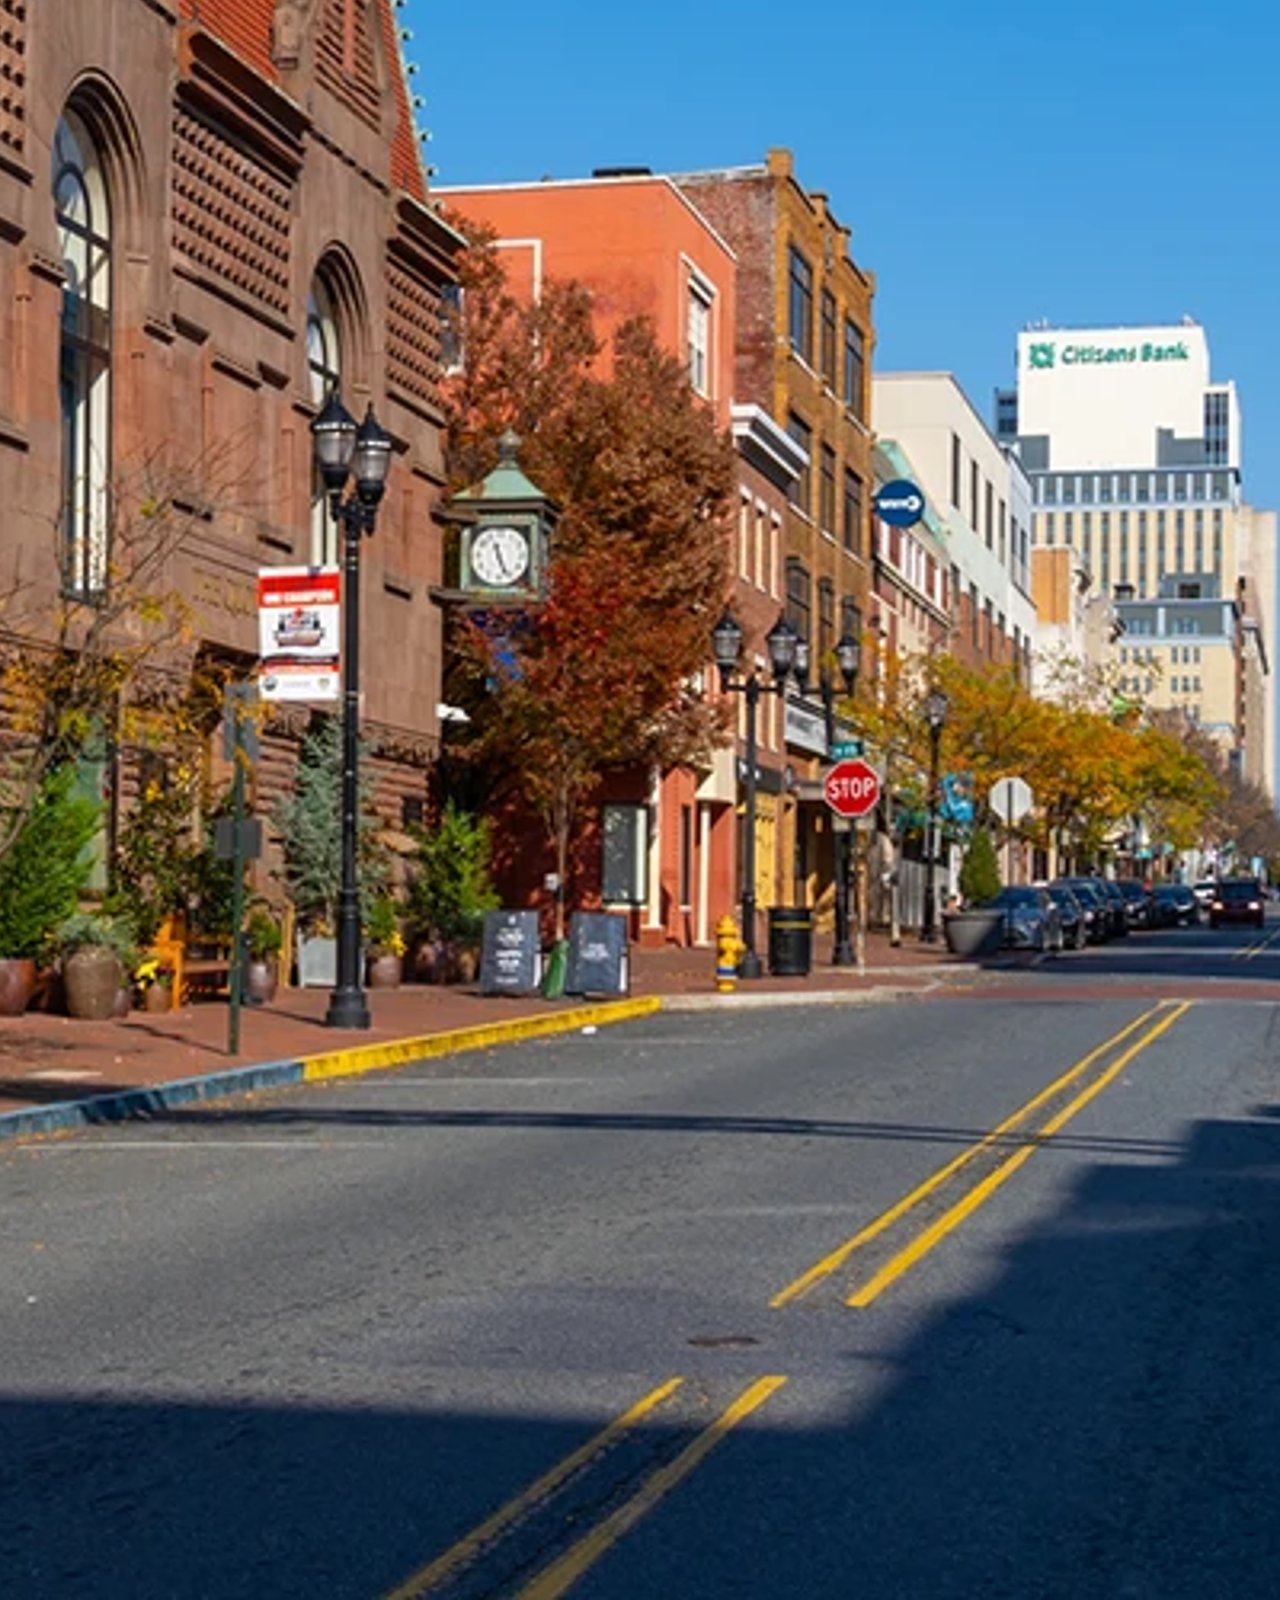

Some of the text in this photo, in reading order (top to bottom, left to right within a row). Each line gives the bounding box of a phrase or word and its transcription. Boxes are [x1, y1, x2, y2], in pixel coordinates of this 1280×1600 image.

[1060, 341, 1189, 366] Citizens Bank
[828, 777, 875, 800] STOP
